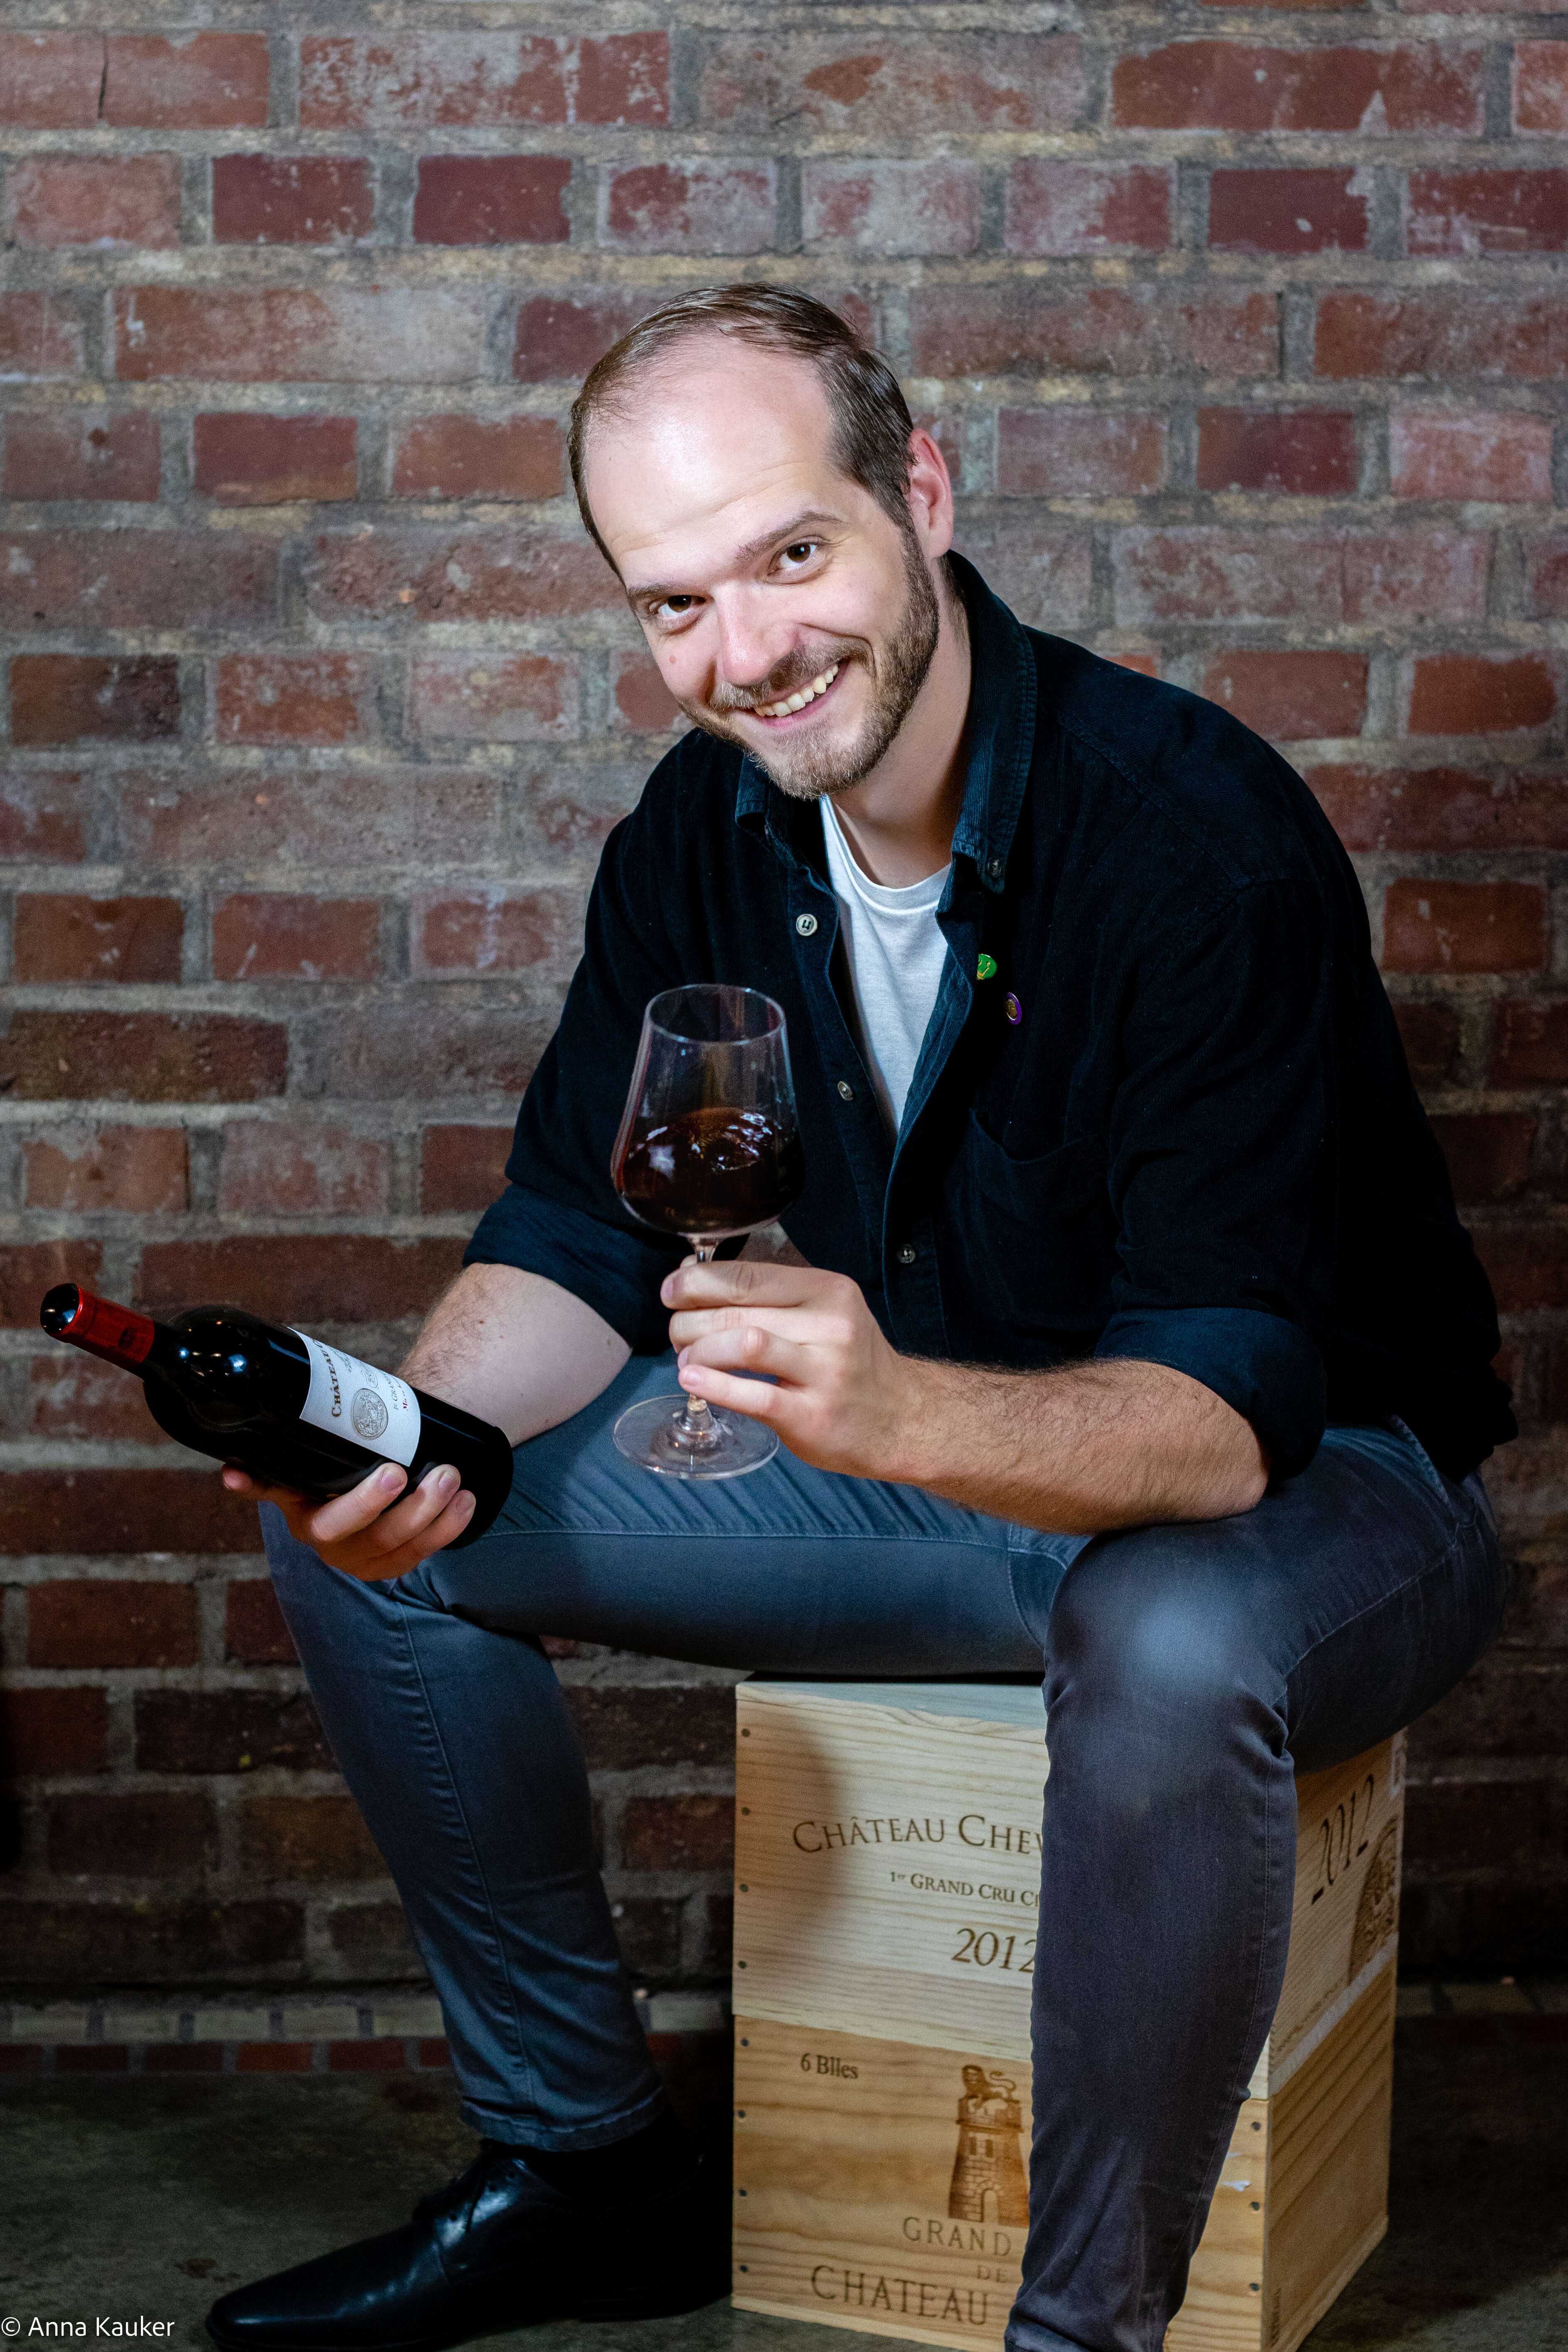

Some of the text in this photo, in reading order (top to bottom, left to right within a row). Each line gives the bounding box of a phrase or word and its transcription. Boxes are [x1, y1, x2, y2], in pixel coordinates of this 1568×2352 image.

[793, 1816, 945, 1853] CHÂTEAU
[1311, 1774, 1374, 1905] 2012
[911, 1873, 973, 1897] GRAND
[978, 1884, 1015, 1903] CRU
[951, 1928, 1037, 1974] 2012
[800, 2053, 810, 2072] 6
[902, 2216, 1012, 2257] GRAND
[977, 2266, 1009, 2283] DE
[811, 2265, 989, 2326] CHATEAU
